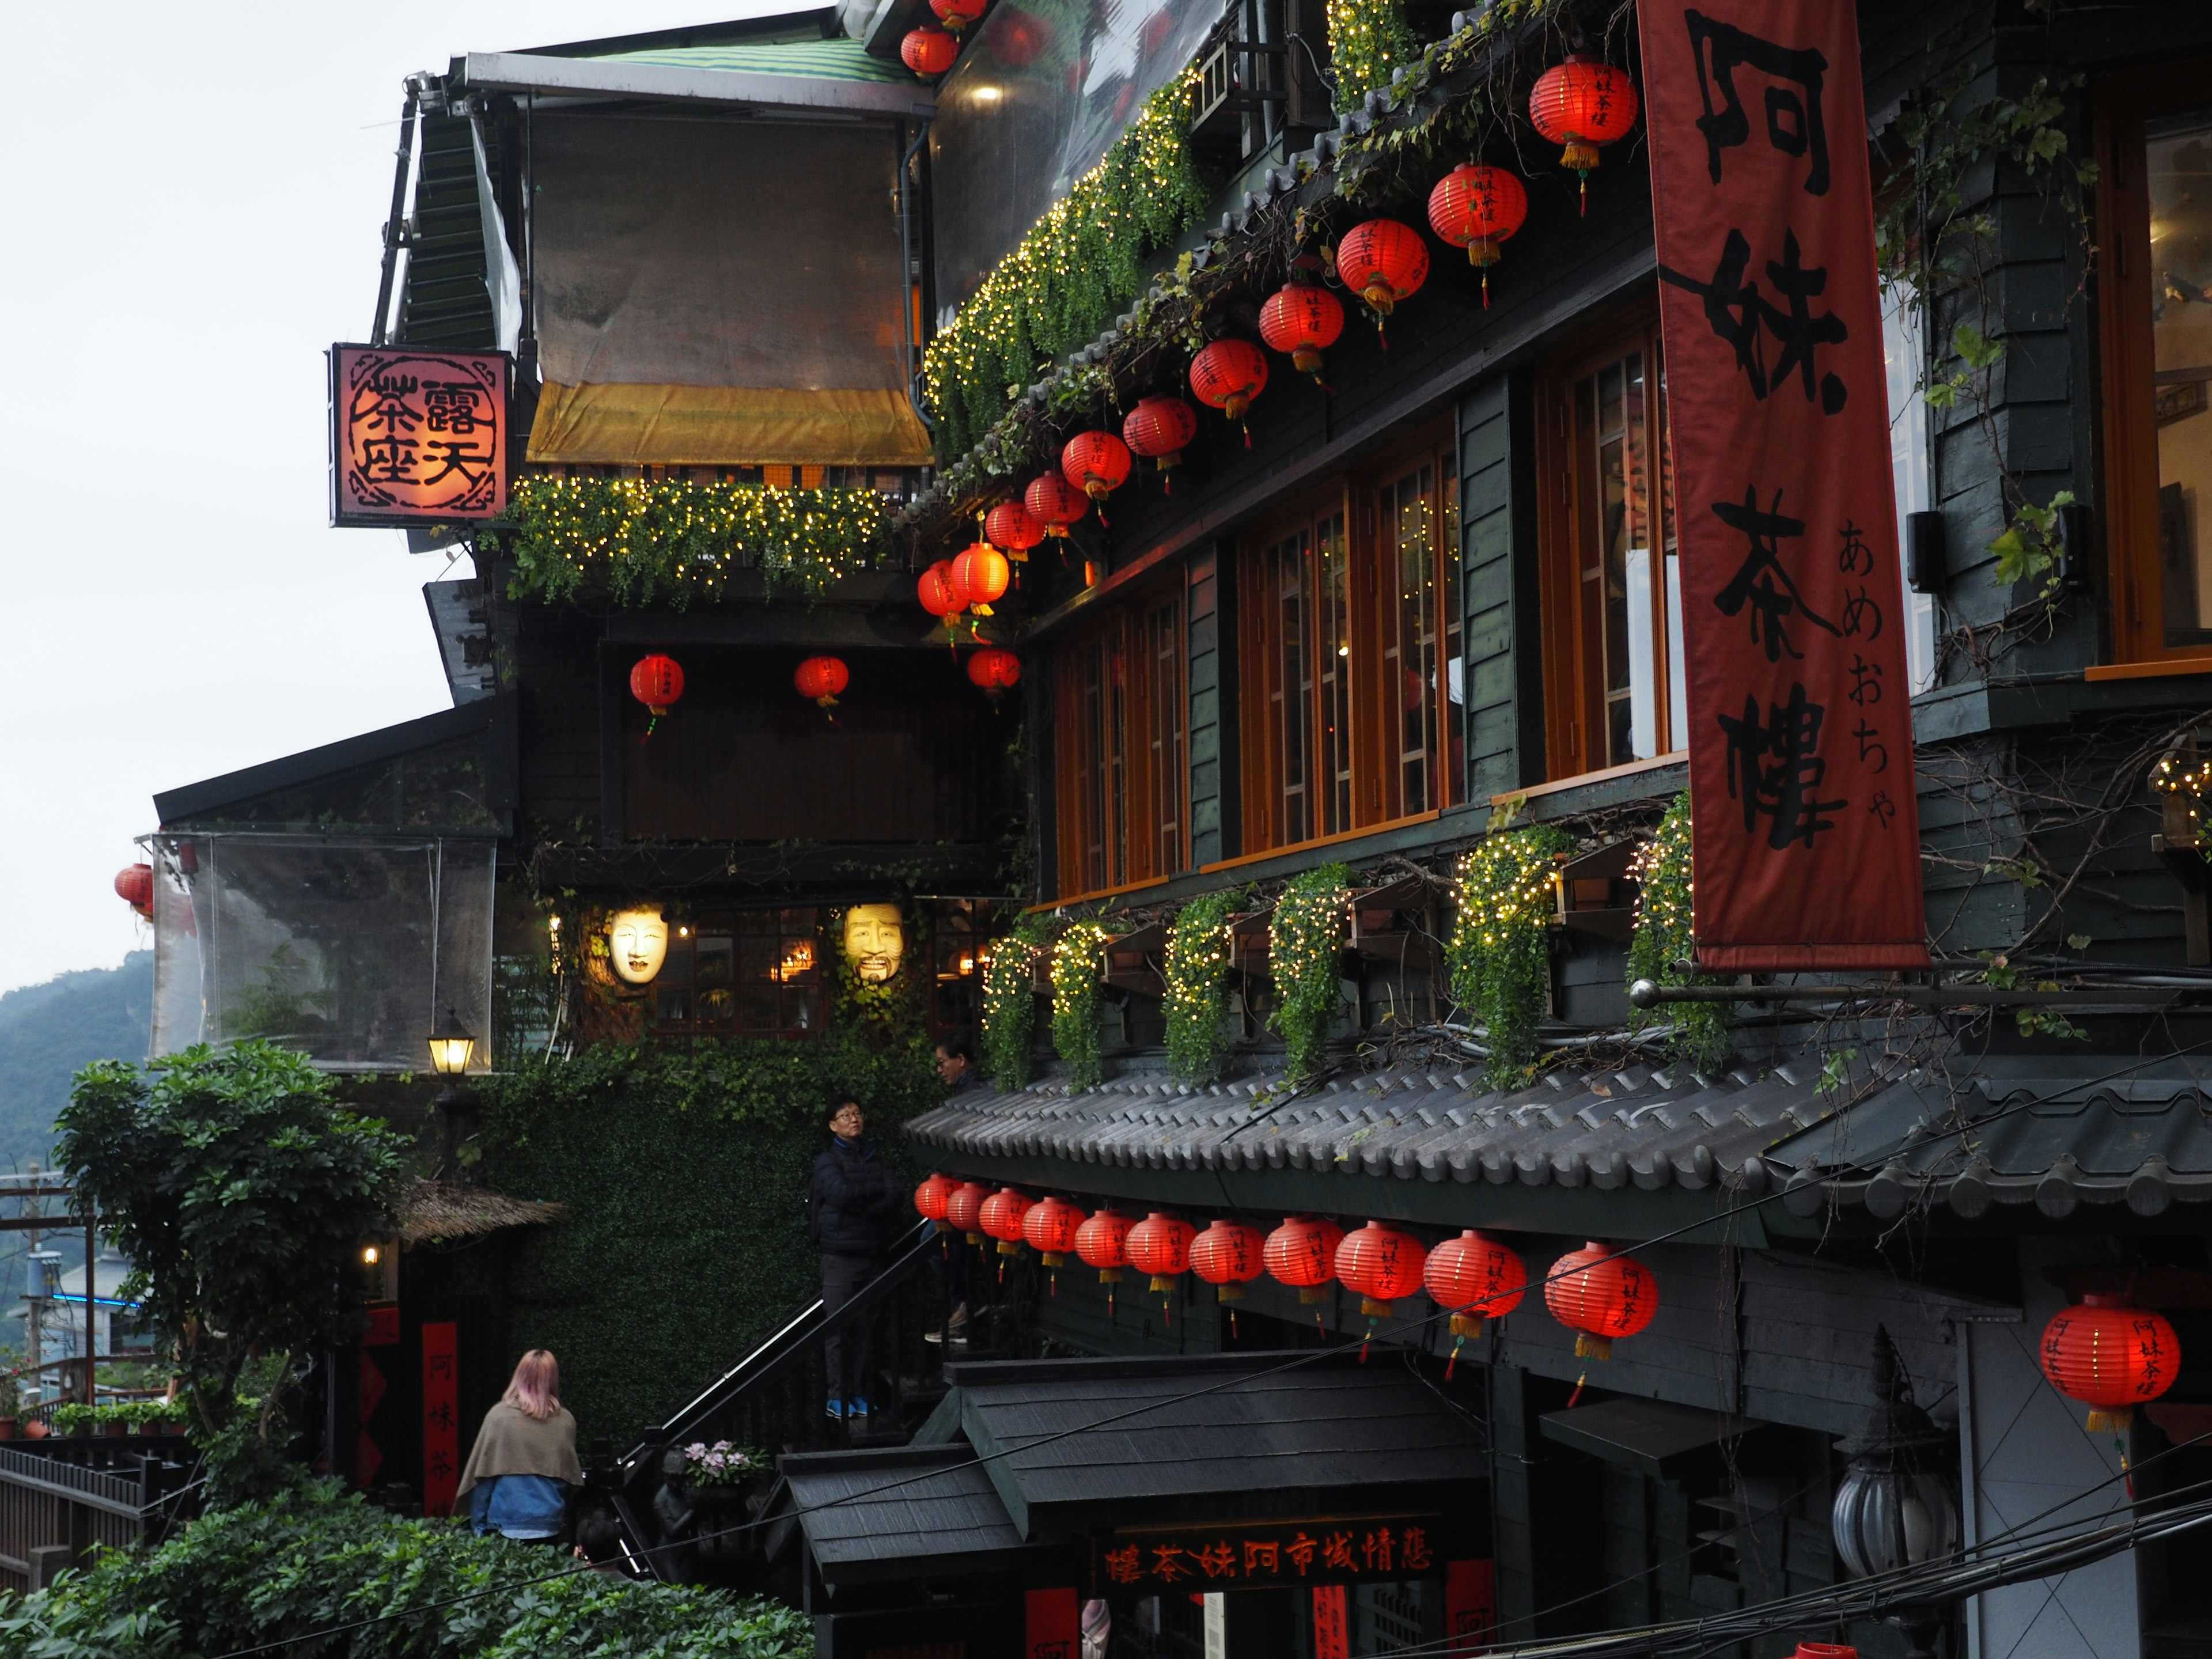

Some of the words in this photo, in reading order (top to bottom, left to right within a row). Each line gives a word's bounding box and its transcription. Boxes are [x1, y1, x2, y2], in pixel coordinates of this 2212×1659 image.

[351, 374, 424, 485] 茶座
[421, 381, 494, 493] 露天
[1658, 8, 1849, 851] 阿妹茶樓
[1838, 518, 1896, 831] あめおちゃ
[2133, 1320, 2164, 1395] 阿妹茶樓
